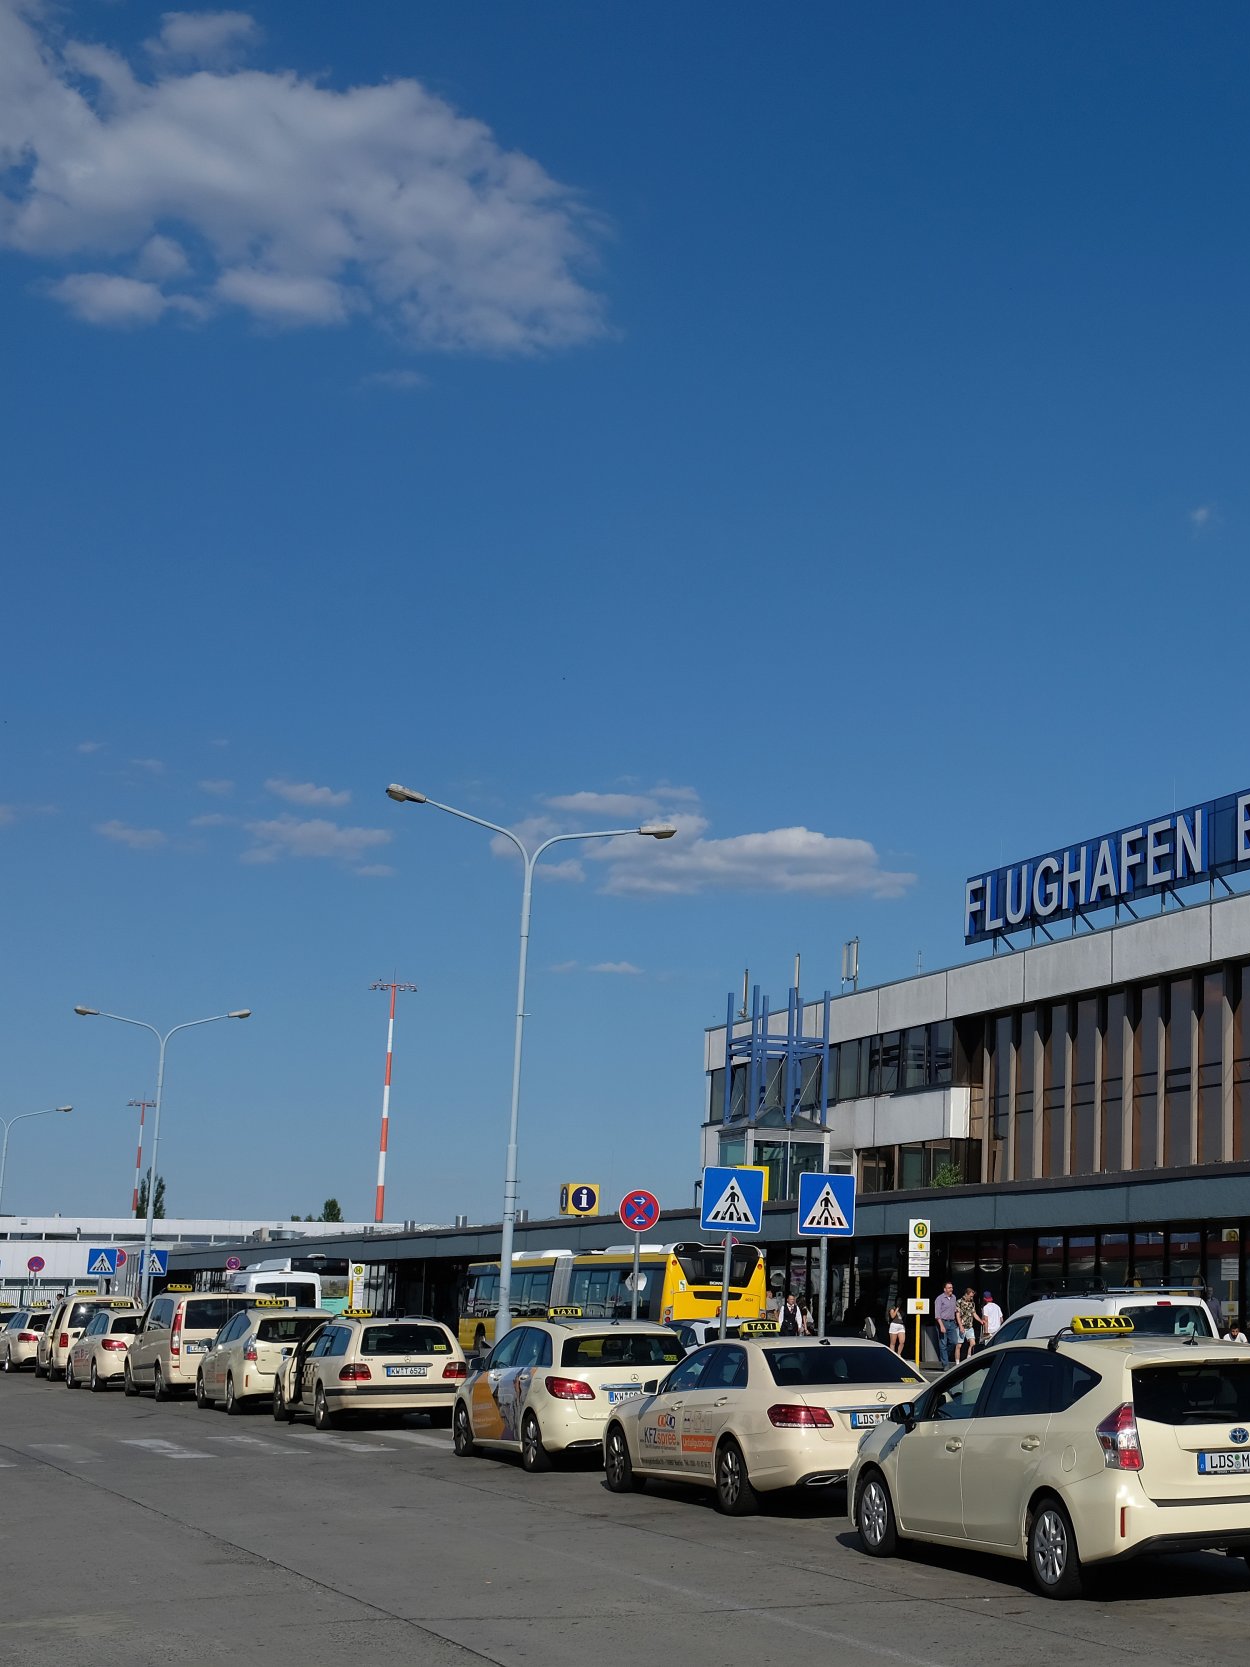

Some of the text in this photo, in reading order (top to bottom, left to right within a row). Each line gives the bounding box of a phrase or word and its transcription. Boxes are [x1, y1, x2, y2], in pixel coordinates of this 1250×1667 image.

[965, 808, 1208, 937] FLUGHAFEN
[750, 1323, 774, 1331] TAXI
[1084, 1316, 1127, 1328] TAXI
[391, 1367, 400, 1375] KW
[409, 1367, 427, 1375] 6521
[614, 1392, 624, 1400] KW
[857, 1414, 875, 1424] LDS
[1210, 1454, 1234, 1468] LDS
[1242, 1453, 1250, 1467] M
